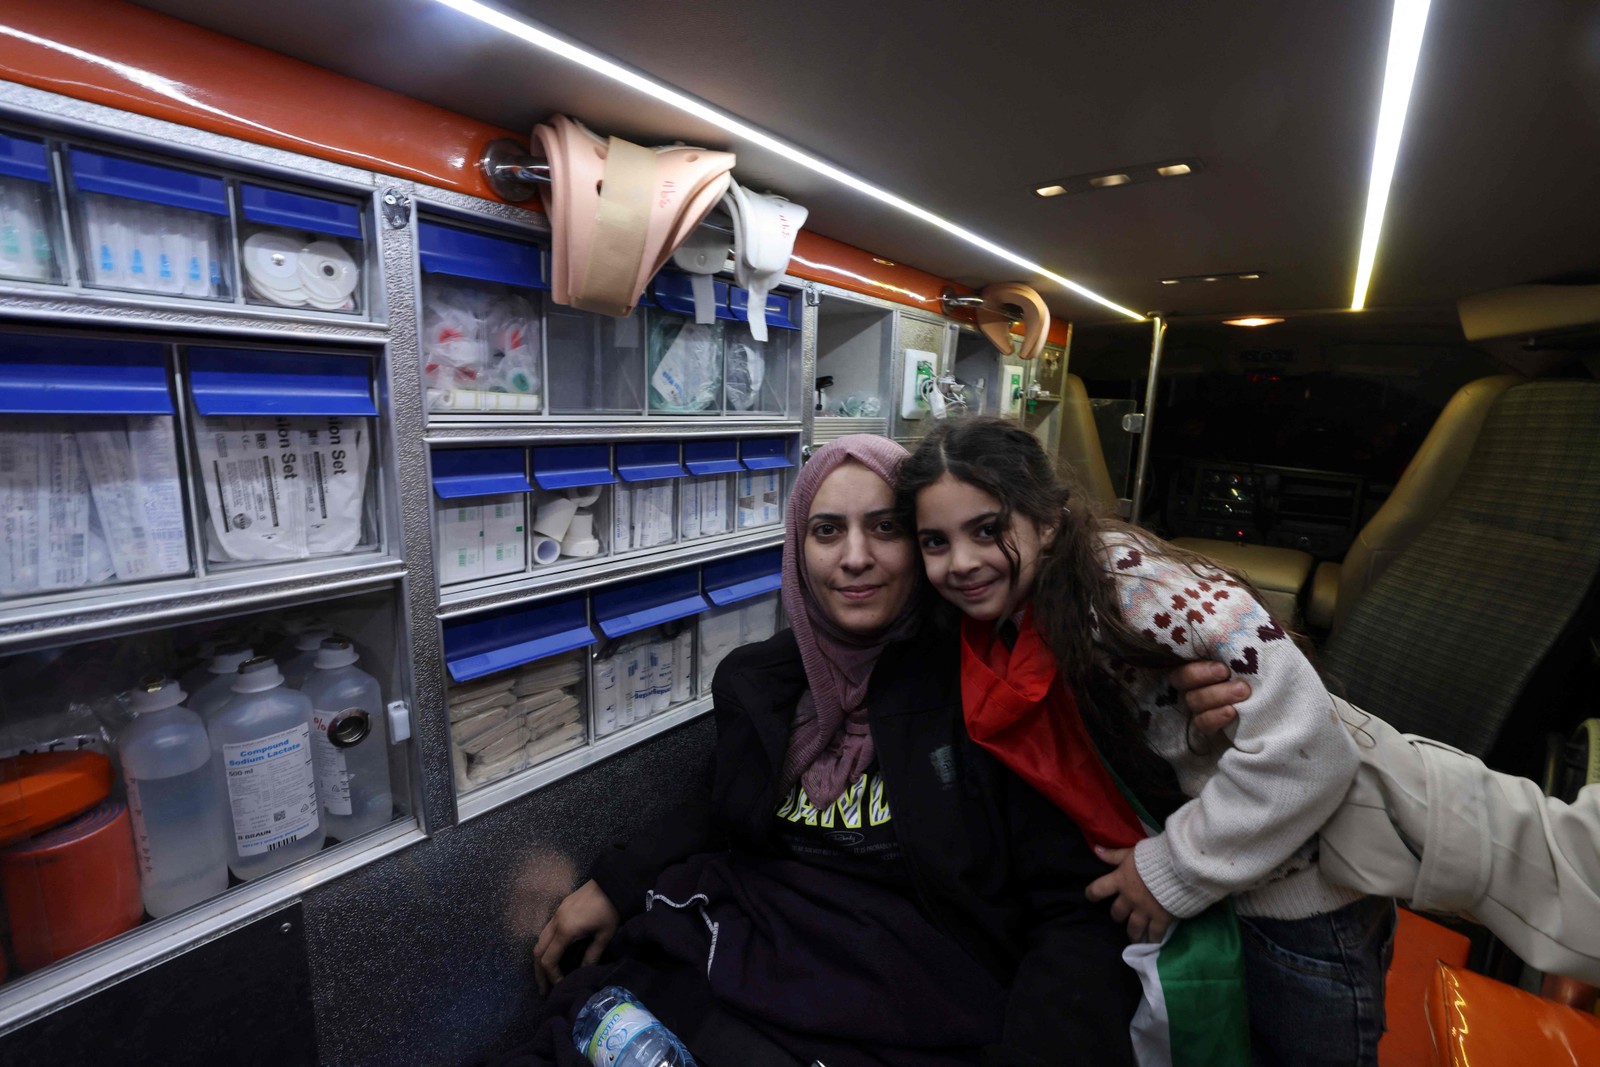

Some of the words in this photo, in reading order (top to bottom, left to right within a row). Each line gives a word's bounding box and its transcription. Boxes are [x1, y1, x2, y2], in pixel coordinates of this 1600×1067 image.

[281, 453, 298, 480] Set
[331, 450, 347, 475] Set
[229, 755, 265, 767] Sodium
[267, 743, 301, 759] Lactate
[240, 739, 289, 758] Compound
[229, 769, 243, 777] 500
[245, 829, 272, 840] BRAUN
